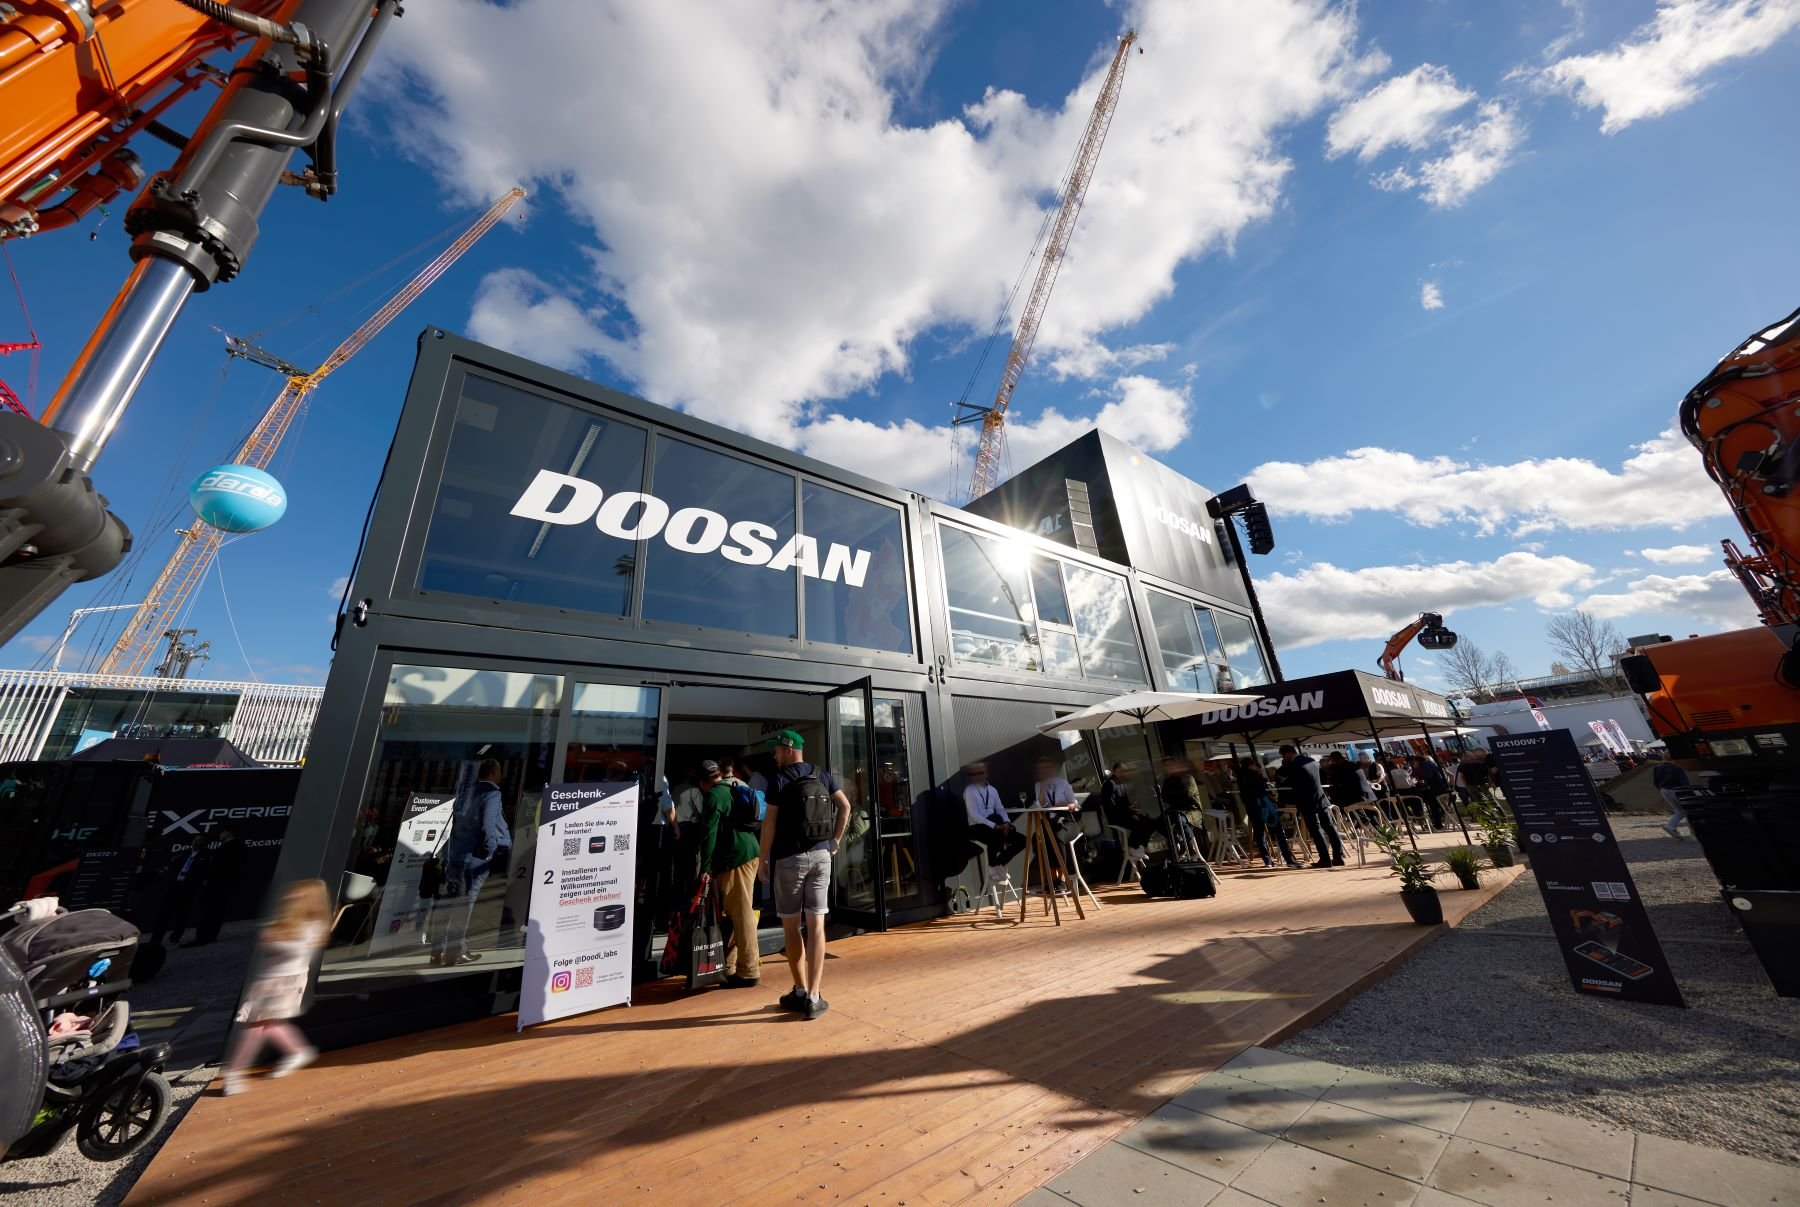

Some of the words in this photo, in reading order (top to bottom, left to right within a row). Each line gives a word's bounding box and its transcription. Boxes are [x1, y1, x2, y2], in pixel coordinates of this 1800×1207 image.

[199, 471, 282, 507] darda
[509, 469, 871, 587] DOOSAN
[1152, 504, 1212, 545] OOSAN
[1371, 686, 1412, 710] DOOSAN
[1201, 690, 1324, 726] DOOSAN
[1421, 699, 1448, 718] DOOSAN
[1496, 737, 1546, 748] DX100W-7
[413, 796, 441, 804] Customer
[551, 789, 606, 800] Geschenk-
[549, 800, 579, 811] Event
[408, 820, 413, 830] 1
[549, 822, 557, 836] 1
[561, 867, 598, 876] Installieren
[544, 870, 554, 885] 2
[561, 875, 593, 883] anmelden
[560, 878, 618, 891] Willkommensmail
[559, 890, 581, 899] zeigen
[583, 888, 596, 896] und
[559, 896, 592, 906] Geschenk
[553, 957, 573, 967] Folge
[1582, 978, 1623, 988] DOOSAN
